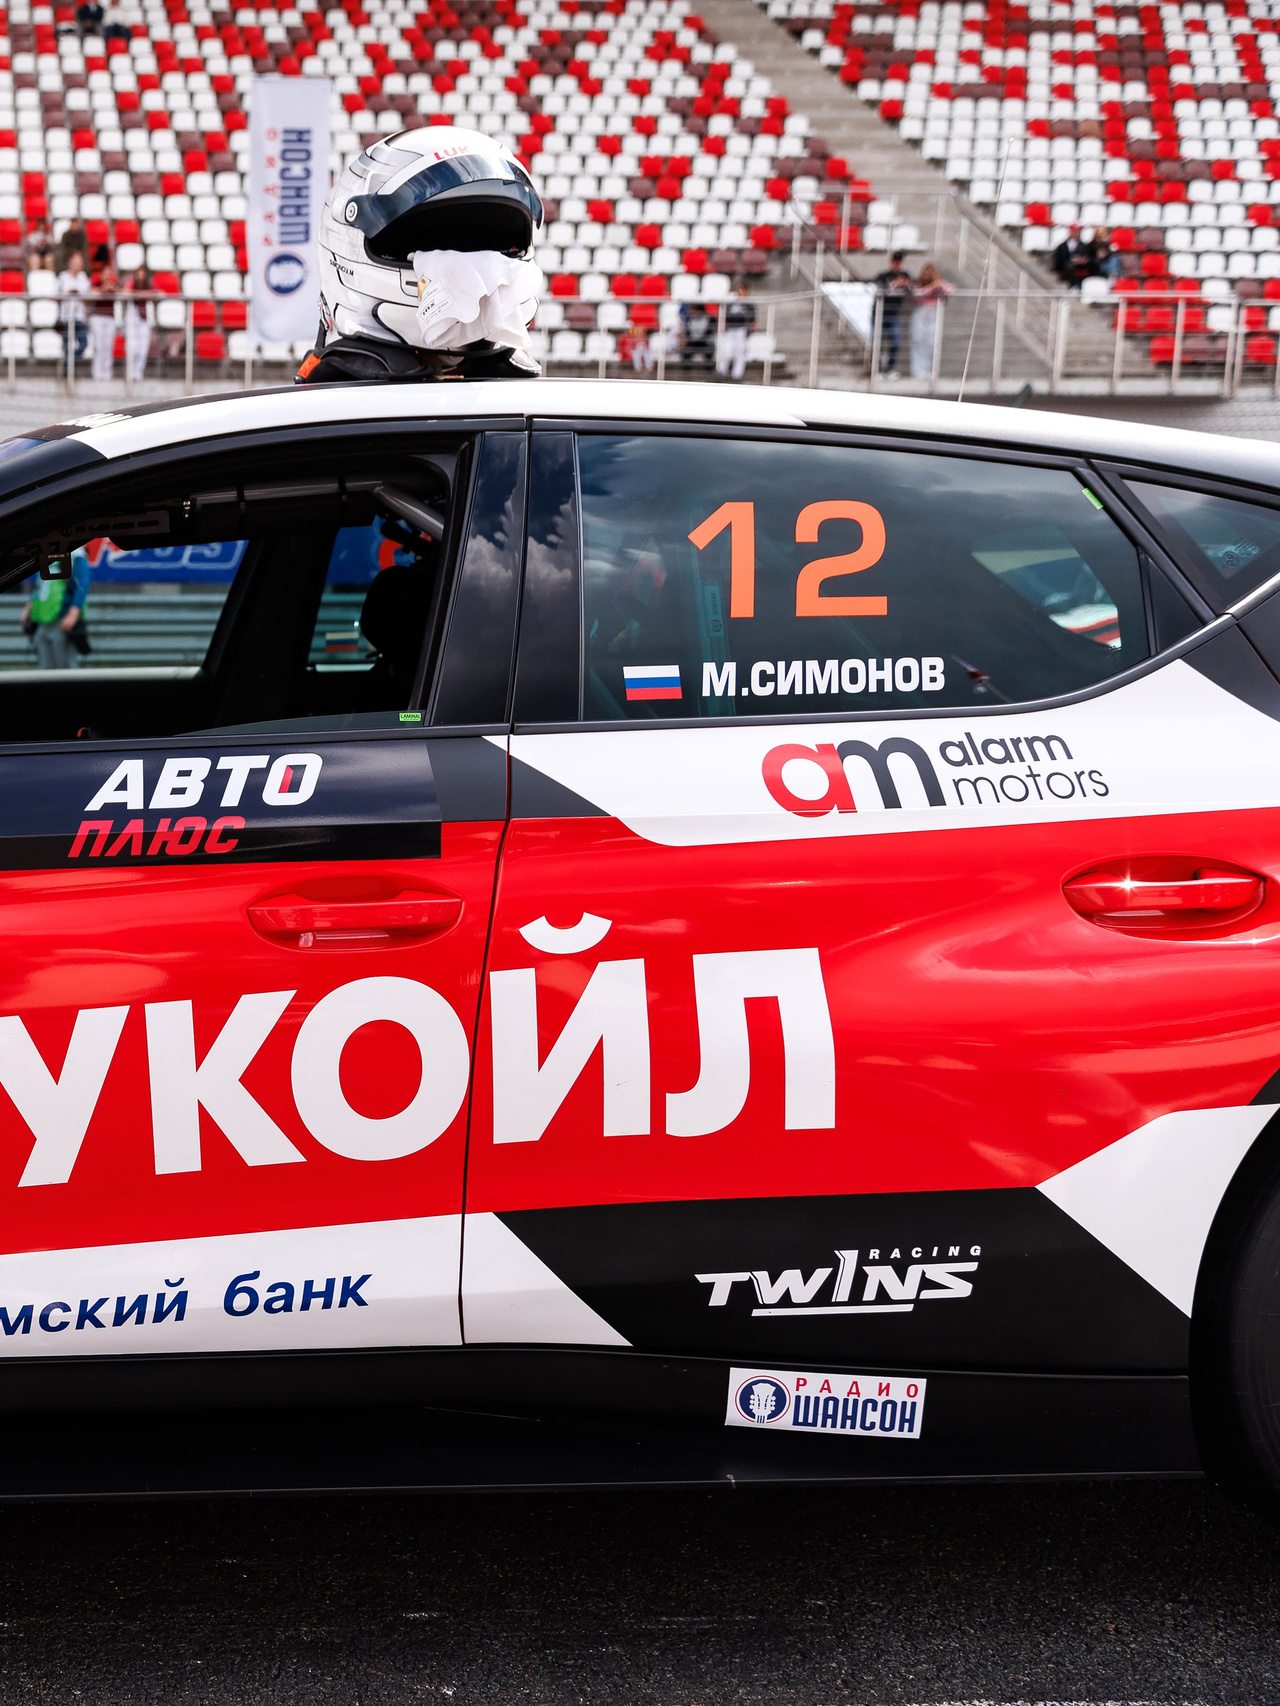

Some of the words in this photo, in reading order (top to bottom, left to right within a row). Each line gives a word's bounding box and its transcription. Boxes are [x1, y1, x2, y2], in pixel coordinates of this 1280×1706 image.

[279, 127, 312, 245] ШАНСОН
[687, 499, 888, 618] 12
[702, 656, 946, 698] М.СИМОНОВ
[939, 732, 1073, 767] alarm
[84, 752, 323, 811] АВТО
[761, 737, 947, 818] am
[952, 765, 1109, 806] motors
[68, 816, 246, 858] ПЛЮС
[869, 1245, 983, 1260] RACING
[223, 1270, 373, 1317] банк
[796, 1377, 920, 1399] РАДИО
[792, 1395, 918, 1434] ШАНСОН
